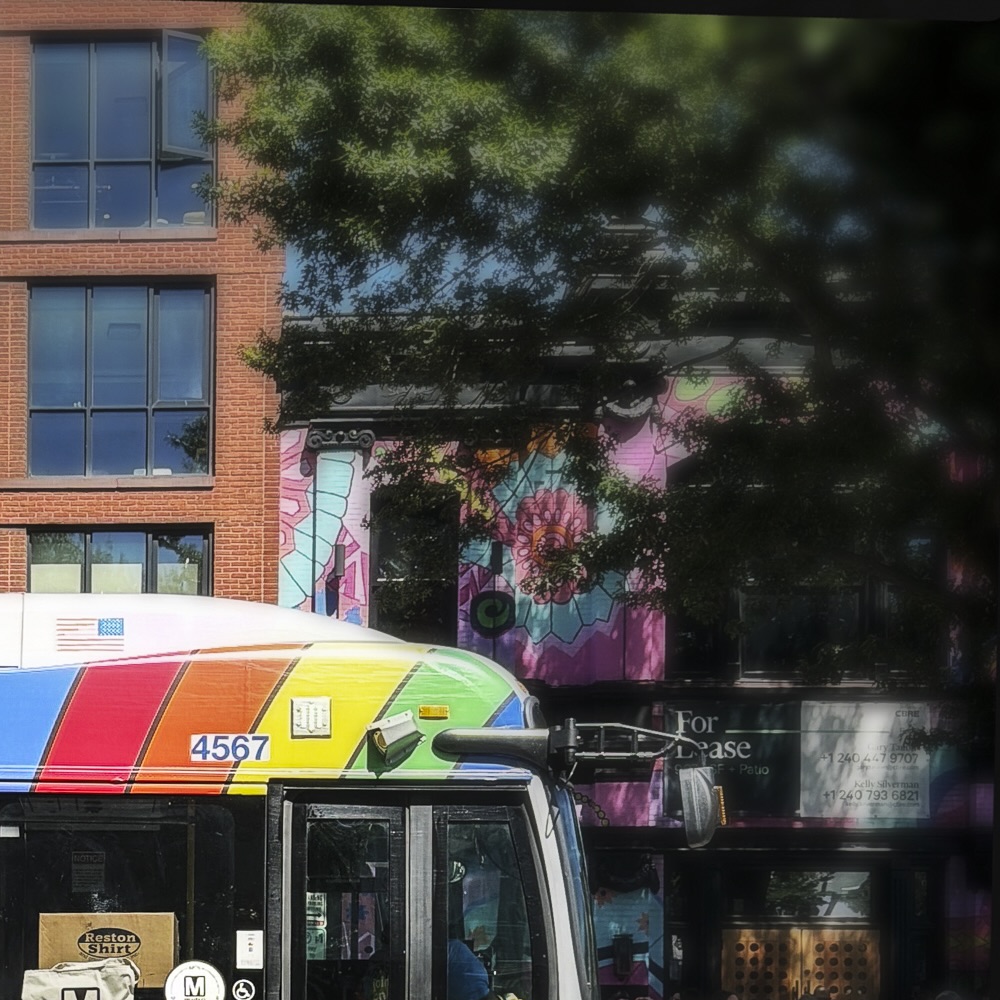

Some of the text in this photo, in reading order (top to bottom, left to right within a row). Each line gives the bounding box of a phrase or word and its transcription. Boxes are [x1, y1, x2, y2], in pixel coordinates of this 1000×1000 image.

[895, 710, 920, 718] CBRE
[675, 710, 719, 734] For
[191, 734, 268, 761] 4567
[820, 753, 919, 764] +1 240 447 9707
[739, 763, 770, 775] Patio
[854, 779, 920, 789] Kelly Silverman
[822, 790, 919, 801] +1 240 793 6821
[73, 854, 104, 863] NOTICE
[85, 932, 136, 943] Reston
[88, 943, 132, 954] Shirt
[184, 976, 206, 997] M
